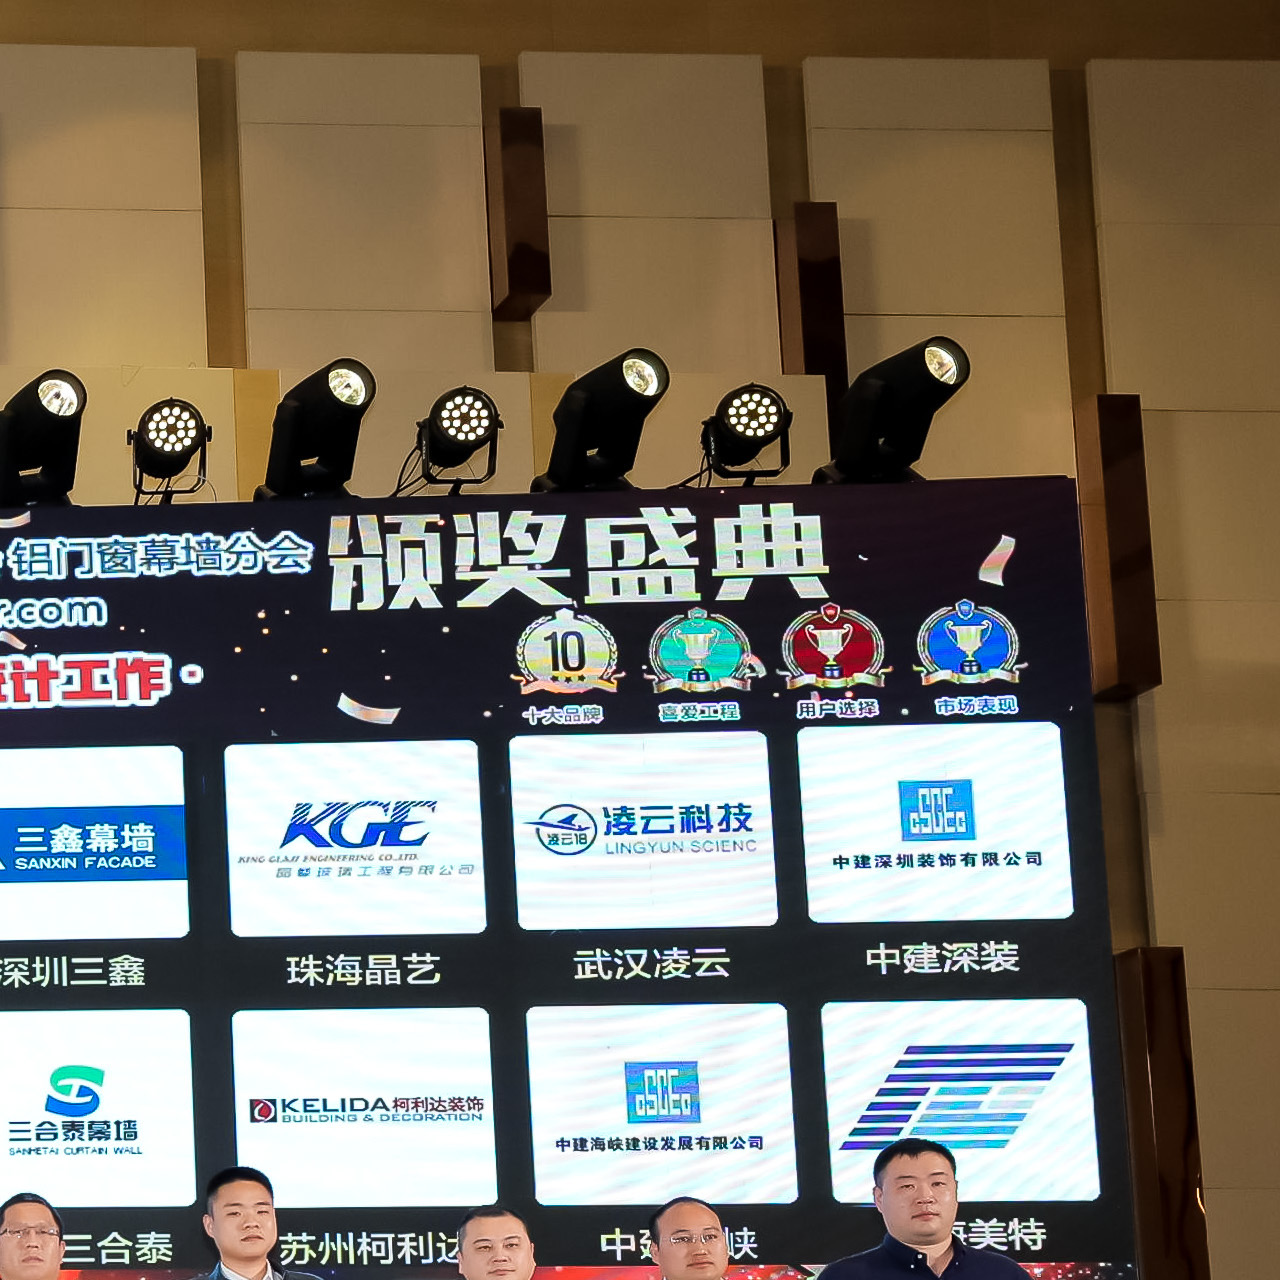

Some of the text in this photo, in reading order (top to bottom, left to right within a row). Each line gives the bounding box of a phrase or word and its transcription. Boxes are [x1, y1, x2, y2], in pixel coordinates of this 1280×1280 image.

[328, 502, 830, 610] 颁奖盛典
[545, 632, 584, 671] 10
[523, 705, 605, 725] 十大品牌
[659, 702, 741, 722] 喜爱工程
[797, 698, 880, 719] 用户选择
[935, 695, 1019, 716] 市场表现
[602, 802, 754, 837] 凌云科技
[14, 822, 156, 855] 三鑫幕墙
[605, 839, 758, 855] LINGYUN SCIENC
[15, 856, 157, 870] SANXIN FACADE
[831, 851, 1044, 871] 中建深圳装饰有限公司
[573, 947, 731, 981] 武汉凌云
[866, 940, 1021, 975] 中建深装
[286, 953, 442, 987] 珠海晶艺
[281, 1114, 358, 1123] BUILDING
[379, 1112, 484, 1122] DECORATION
[8, 1119, 138, 1142] 三合泰幕墙
[555, 1135, 764, 1152] 中建海峡建设发展有限公司
